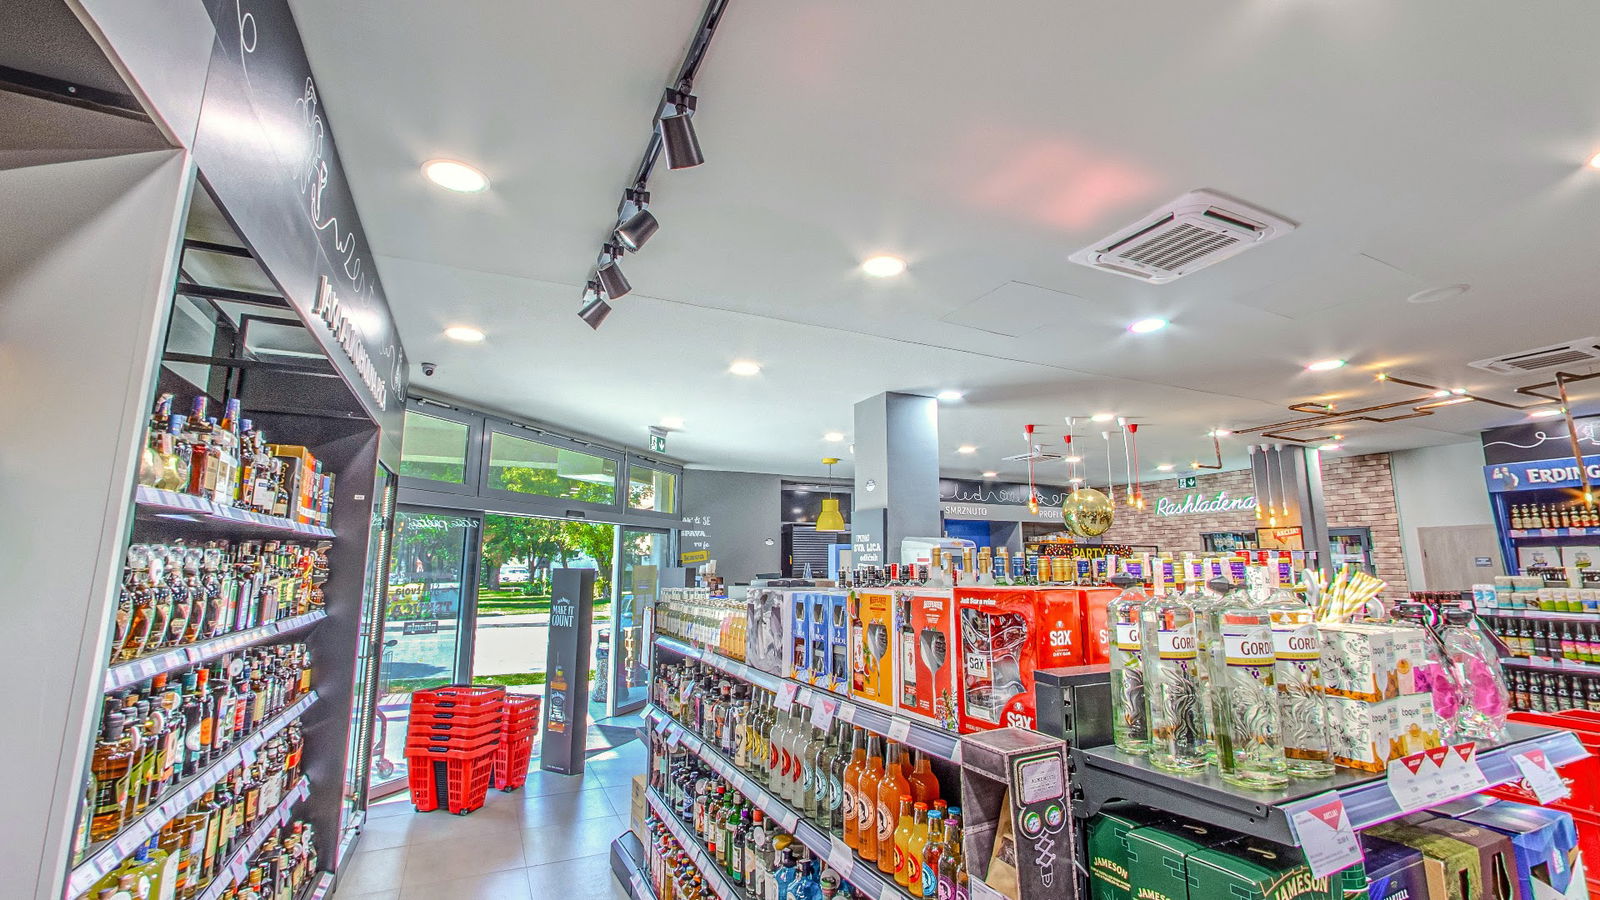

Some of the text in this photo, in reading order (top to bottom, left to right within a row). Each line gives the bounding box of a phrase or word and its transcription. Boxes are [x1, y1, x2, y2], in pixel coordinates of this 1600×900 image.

[945, 506, 987, 516] SMRZNUTO
[1039, 510, 1059, 518] PROFI
[553, 605, 575, 615] MAKE IT
[552, 615, 574, 627] COUNT
[1049, 630, 1072, 646] sax
[969, 656, 985, 670] sax
[1094, 856, 1128, 880] JAMESON
[1137, 887, 1171, 900] JAMES
